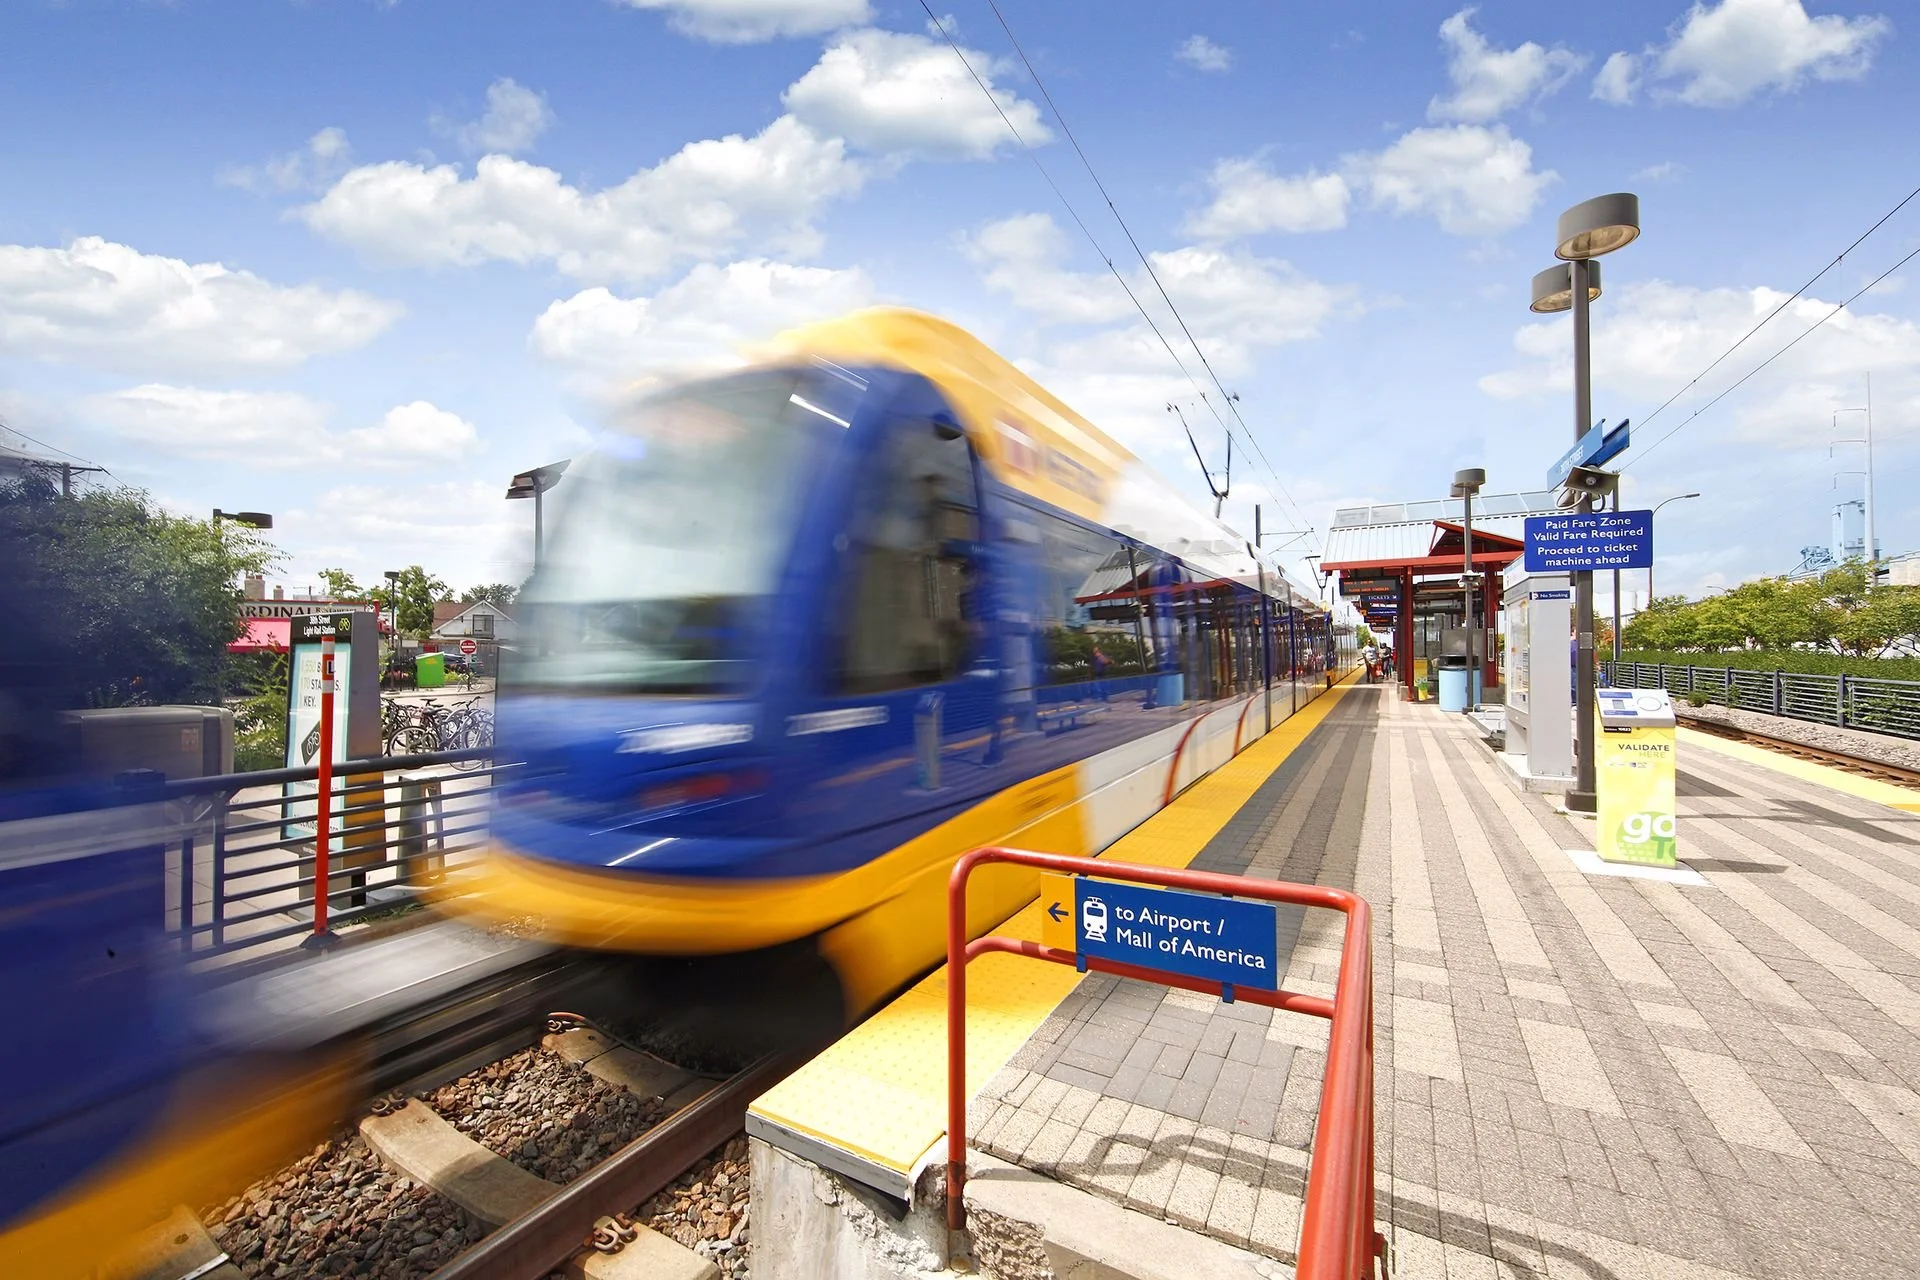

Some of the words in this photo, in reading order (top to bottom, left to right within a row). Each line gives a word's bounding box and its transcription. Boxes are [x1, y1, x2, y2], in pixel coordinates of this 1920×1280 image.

[1545, 520, 1568, 530] Paid
[1572, 519, 1596, 528] Fare
[1600, 517, 1631, 527] Zone
[1533, 532, 1559, 541] Valid
[1563, 531, 1587, 540] Fare
[1591, 527, 1643, 539] Required
[1537, 545, 1583, 555] Proceed
[1604, 543, 1638, 552] ticket
[1545, 557, 1591, 566] machine
[1595, 554, 1630, 565] ahead
[318, 615, 330, 624] Street
[303, 626, 313, 637] Light
[322, 625, 336, 635] Station
[1618, 744, 1670, 752] VALIDATE
[1115, 905, 1135, 922] to
[1138, 907, 1211, 934] Airport
[1116, 926, 1152, 949] Mall
[1158, 937, 1178, 954] of
[1181, 939, 1267, 970] America
